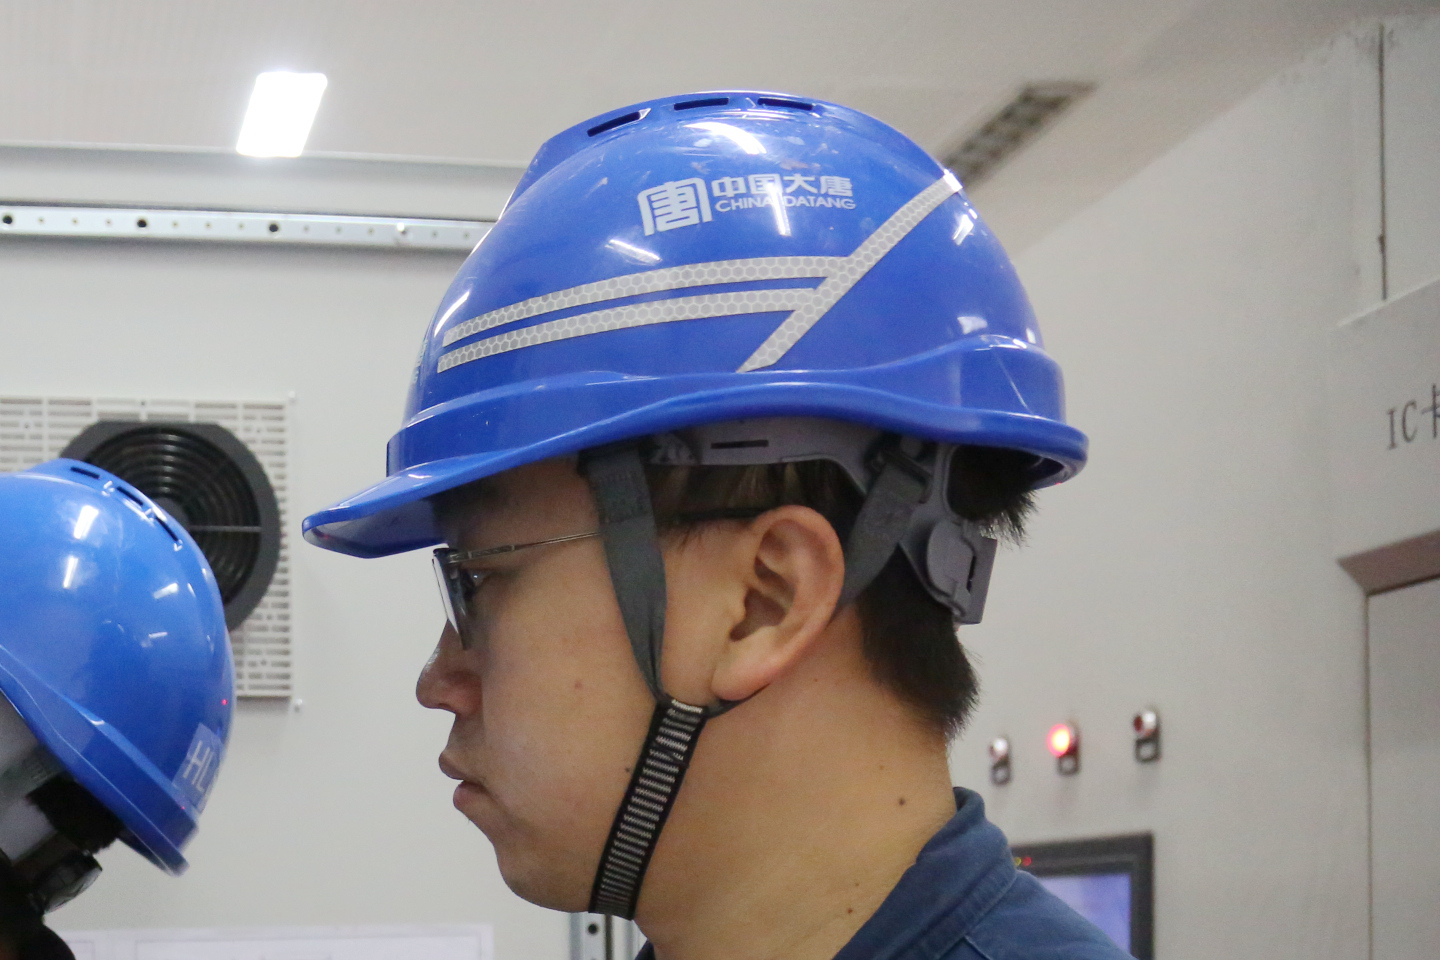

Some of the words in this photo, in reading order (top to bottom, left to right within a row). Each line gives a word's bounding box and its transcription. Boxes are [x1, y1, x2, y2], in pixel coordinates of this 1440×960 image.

[711, 173, 854, 198] 中国大唐
[715, 197, 774, 213] CHINA
[782, 196, 857, 210] DATANG
